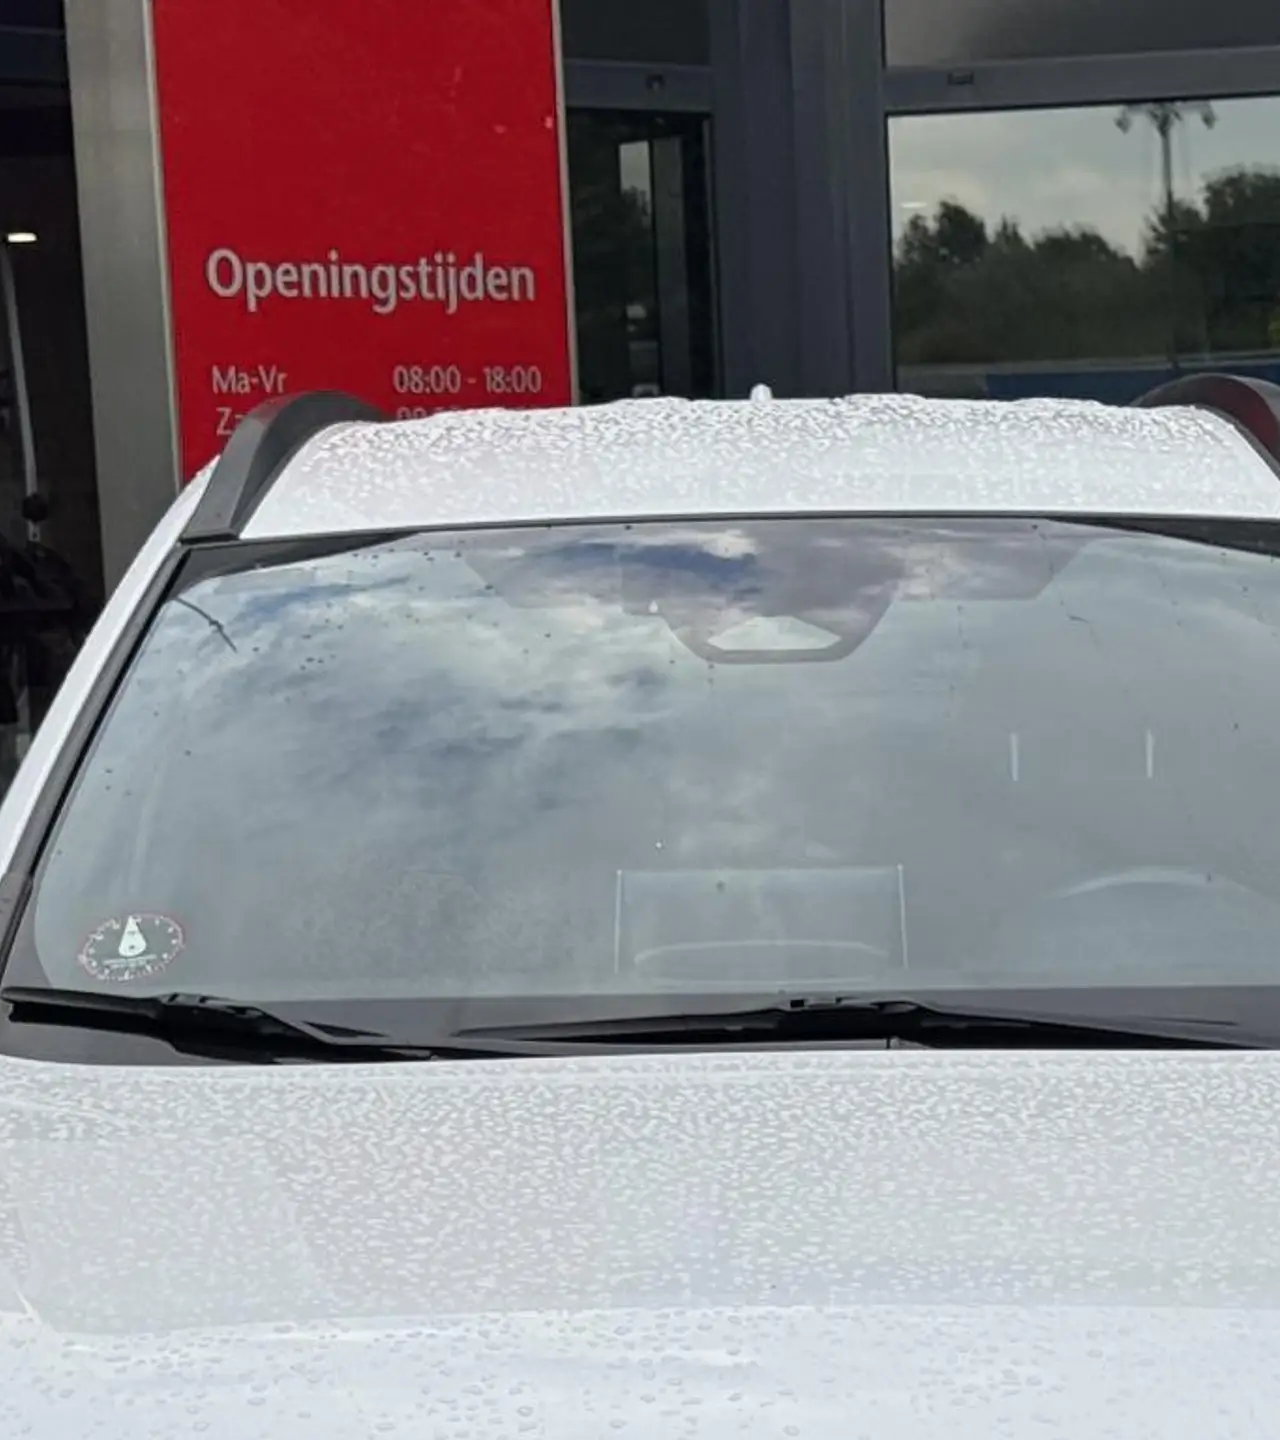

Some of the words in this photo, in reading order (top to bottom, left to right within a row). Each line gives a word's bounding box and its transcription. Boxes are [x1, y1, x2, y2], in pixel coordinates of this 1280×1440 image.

[206, 248, 535, 314] Openingstijden
[212, 364, 288, 395] Ma-Vr
[393, 365, 461, 394] 08:00
[483, 365, 542, 395] 18:00
